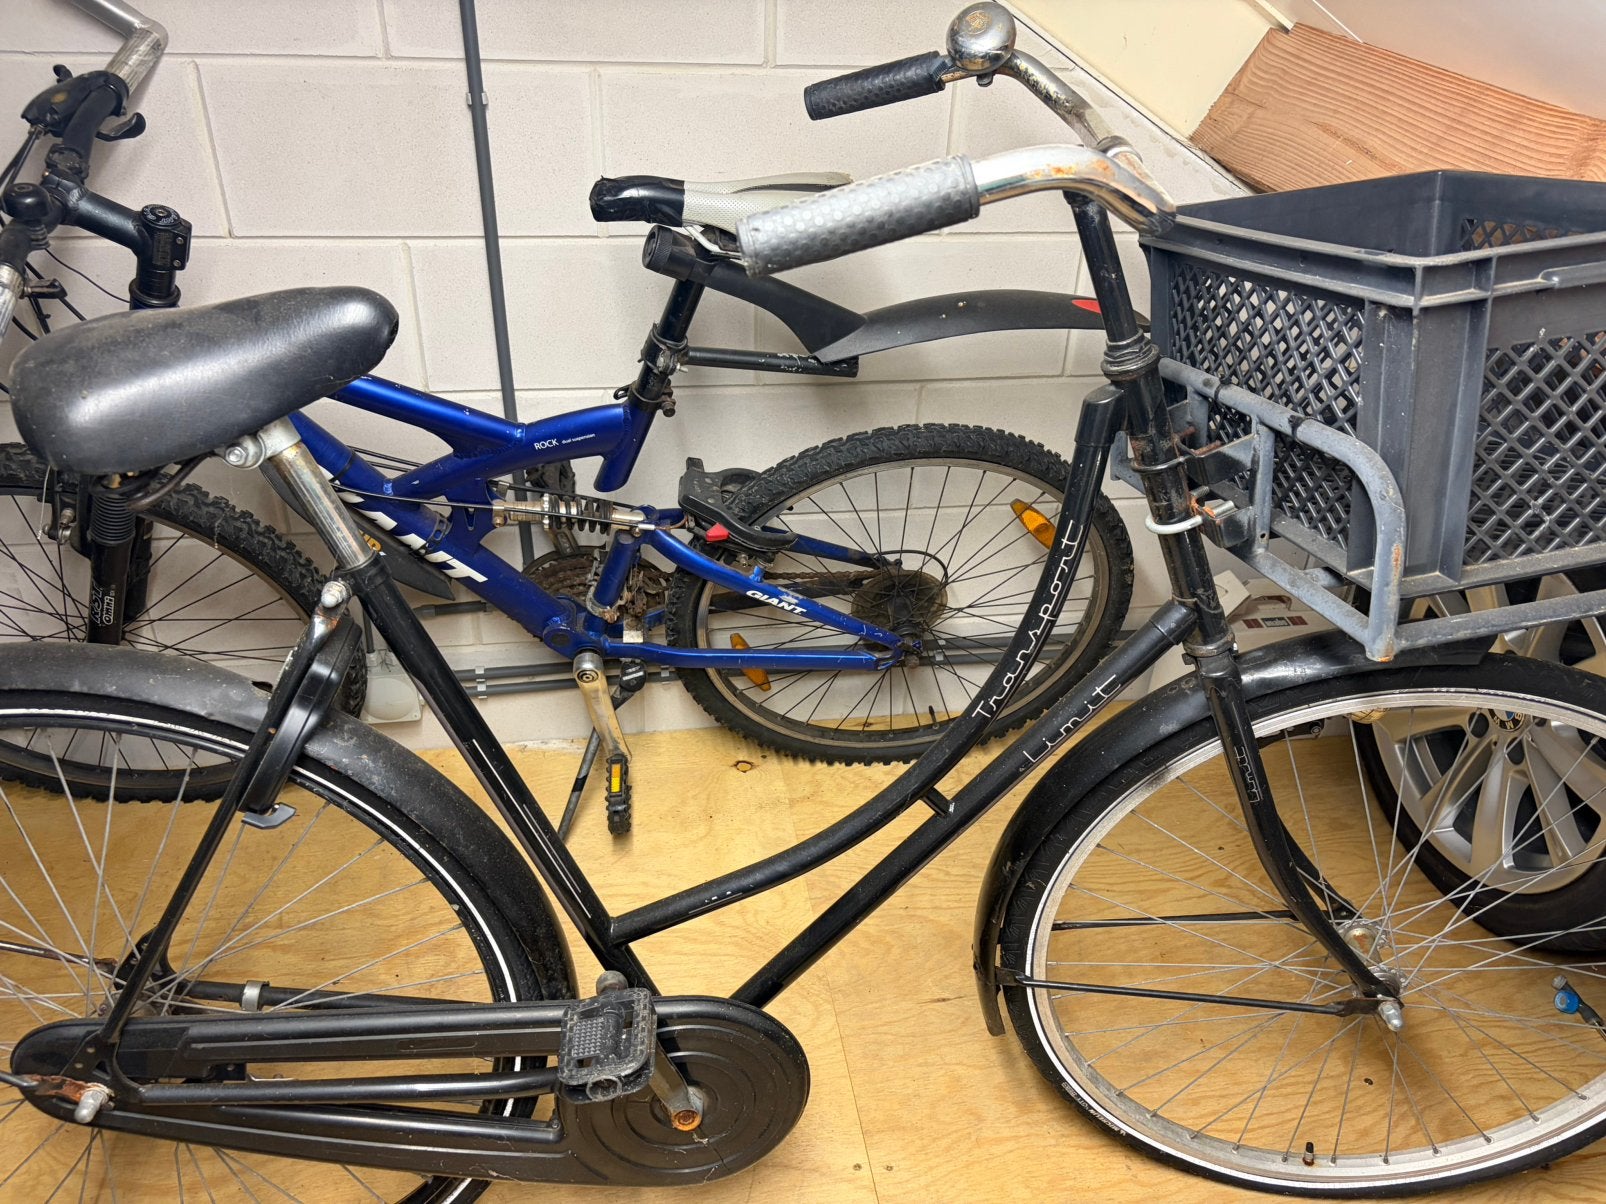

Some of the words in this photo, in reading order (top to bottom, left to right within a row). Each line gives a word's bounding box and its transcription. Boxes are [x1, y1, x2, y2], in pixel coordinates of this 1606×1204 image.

[534, 438, 559, 450] ROCK
[745, 590, 807, 614] GIANT
[972, 519, 1084, 719] Transport
[1022, 673, 1121, 764] Limit
[1088, 1108, 1120, 1131] MICHELIN
